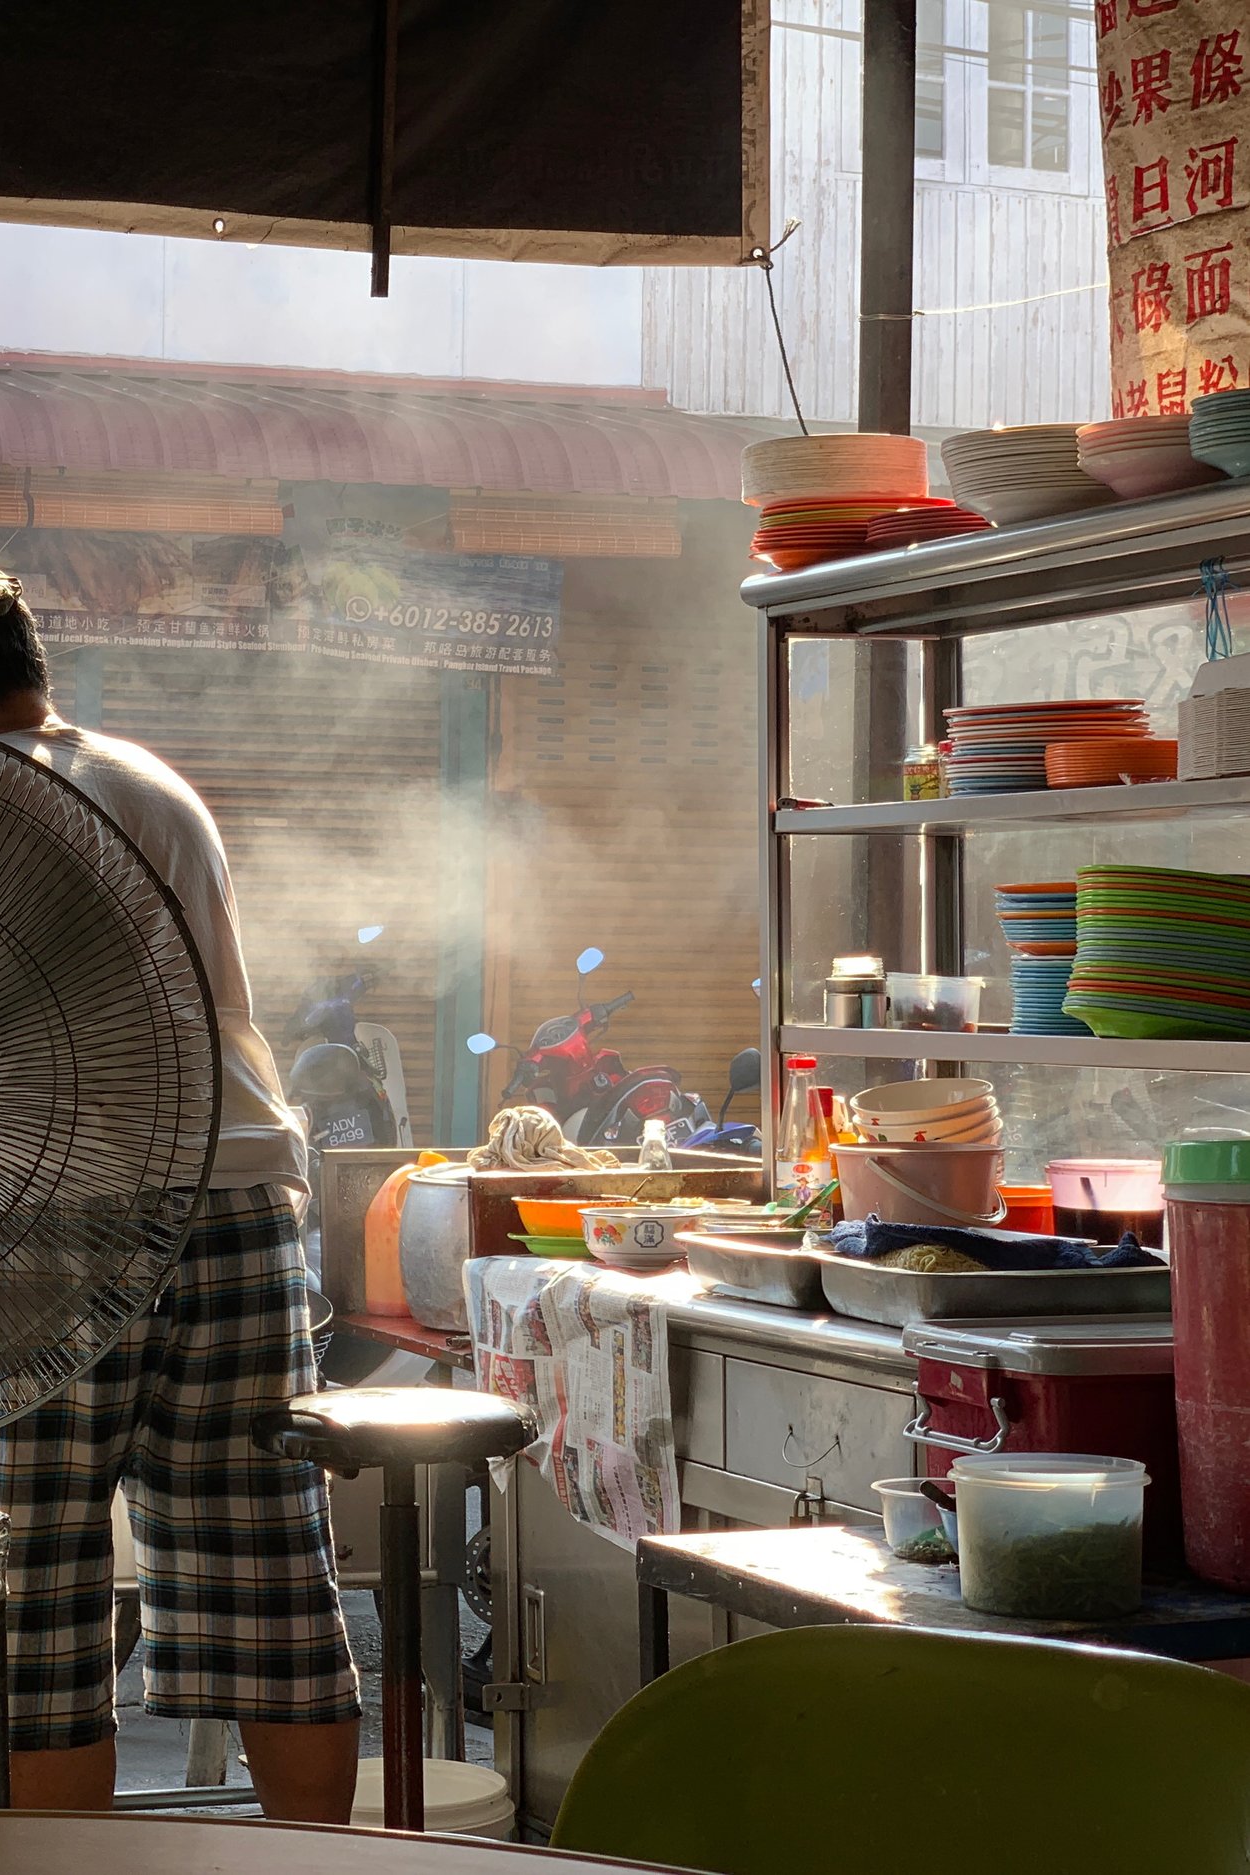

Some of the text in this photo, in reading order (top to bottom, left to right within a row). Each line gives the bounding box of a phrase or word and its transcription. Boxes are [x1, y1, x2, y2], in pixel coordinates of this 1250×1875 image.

[1113, 241, 1234, 343] 碌面
[60, 633, 83, 644] Local
[216, 639, 237, 651] Style
[499, 663, 520, 674] Travel
[521, 664, 552, 676] Package
[332, 1116, 356, 1134] ADV
[328, 1127, 365, 1147] 8499
